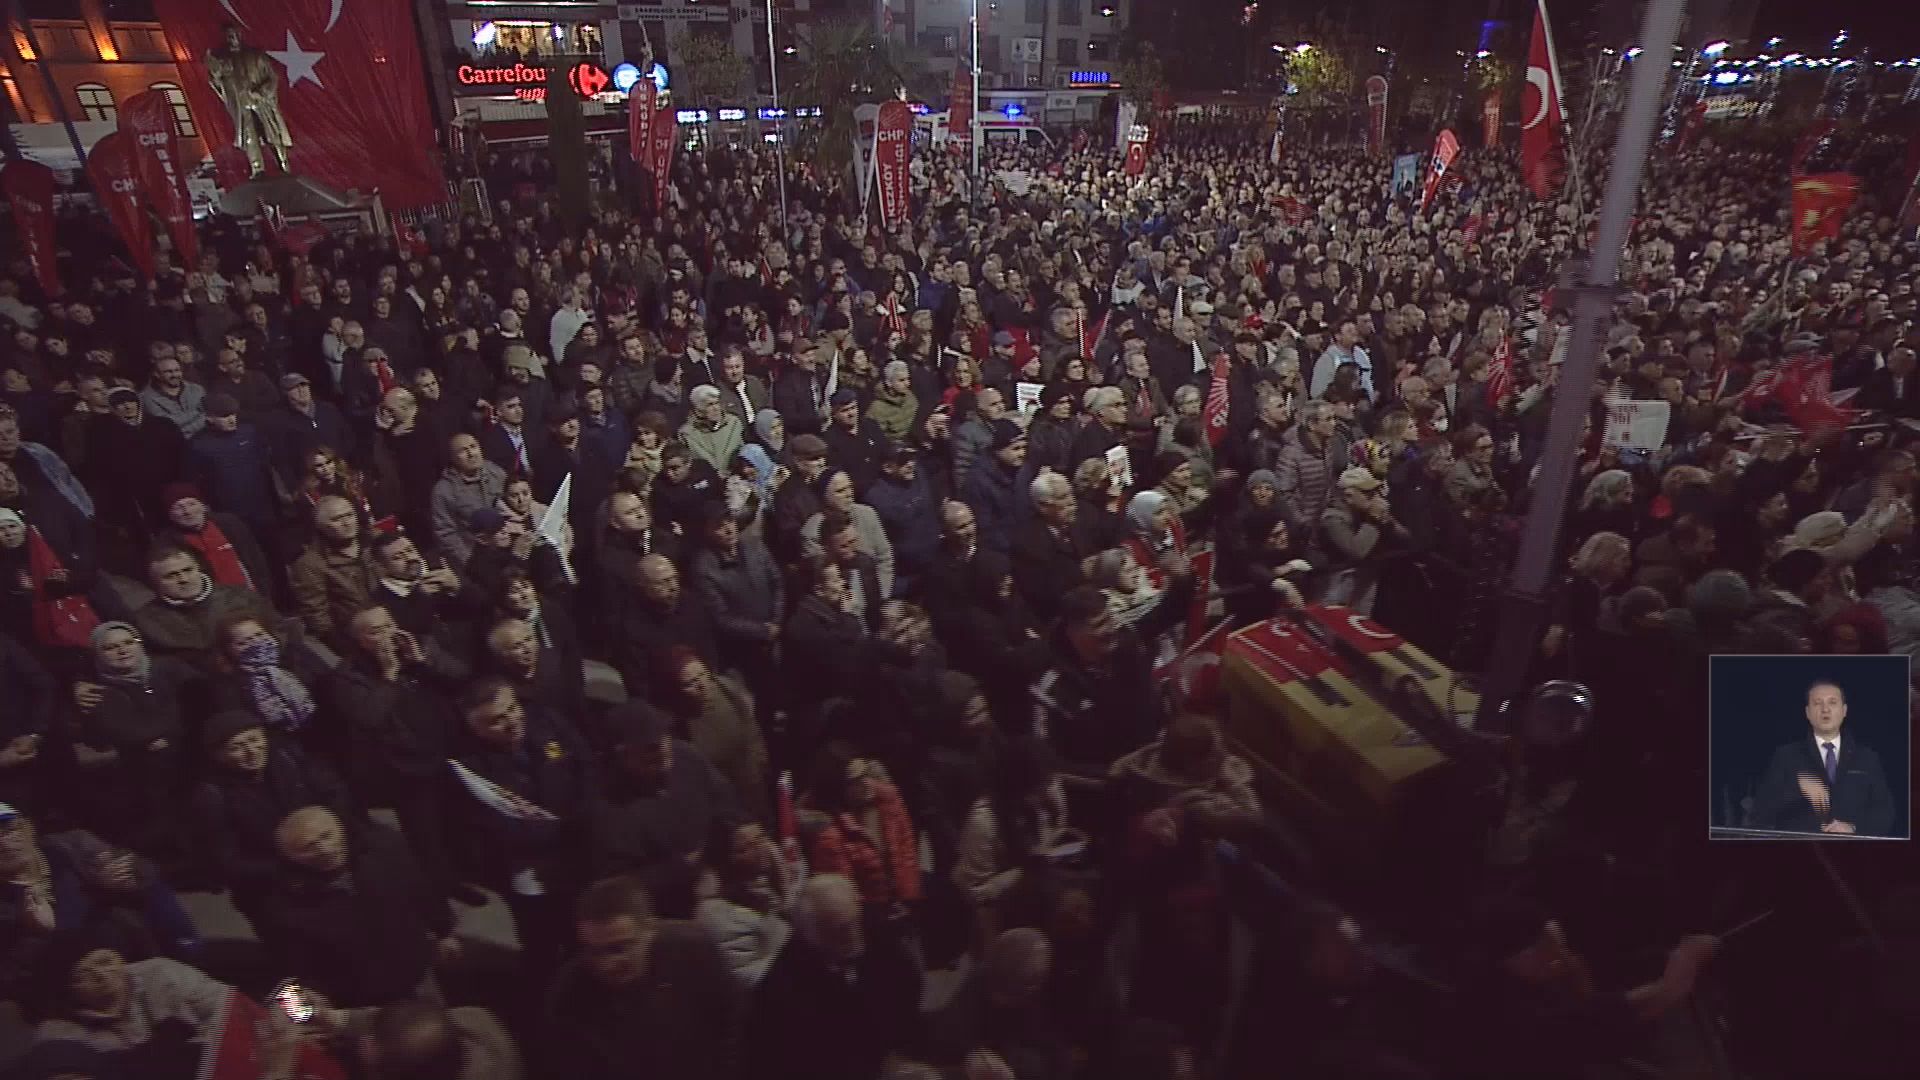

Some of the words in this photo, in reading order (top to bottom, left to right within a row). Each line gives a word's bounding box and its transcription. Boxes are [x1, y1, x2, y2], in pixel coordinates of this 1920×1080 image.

[458, 63, 548, 84] Carrefou
[878, 129, 904, 142] CHP
[111, 178, 136, 193] CH
